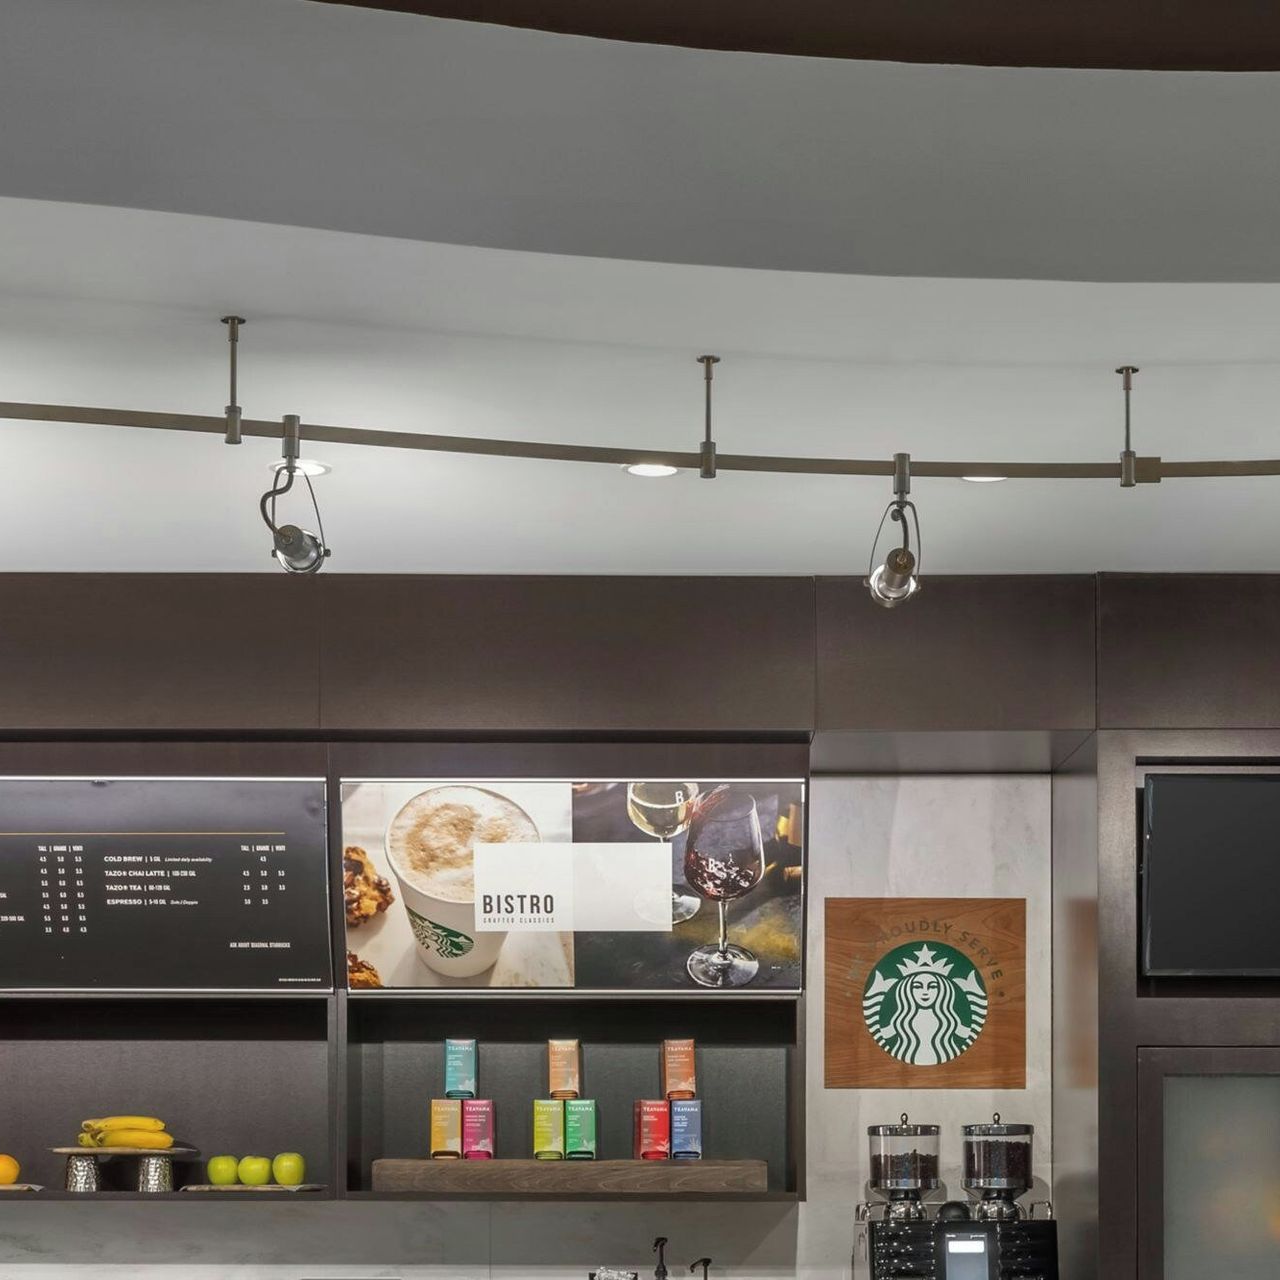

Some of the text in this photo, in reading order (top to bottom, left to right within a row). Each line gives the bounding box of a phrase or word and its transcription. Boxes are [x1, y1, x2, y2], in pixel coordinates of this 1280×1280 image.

[483, 894, 554, 914] BISTRO
[872, 920, 1006, 981] ROUDLY SERVE
